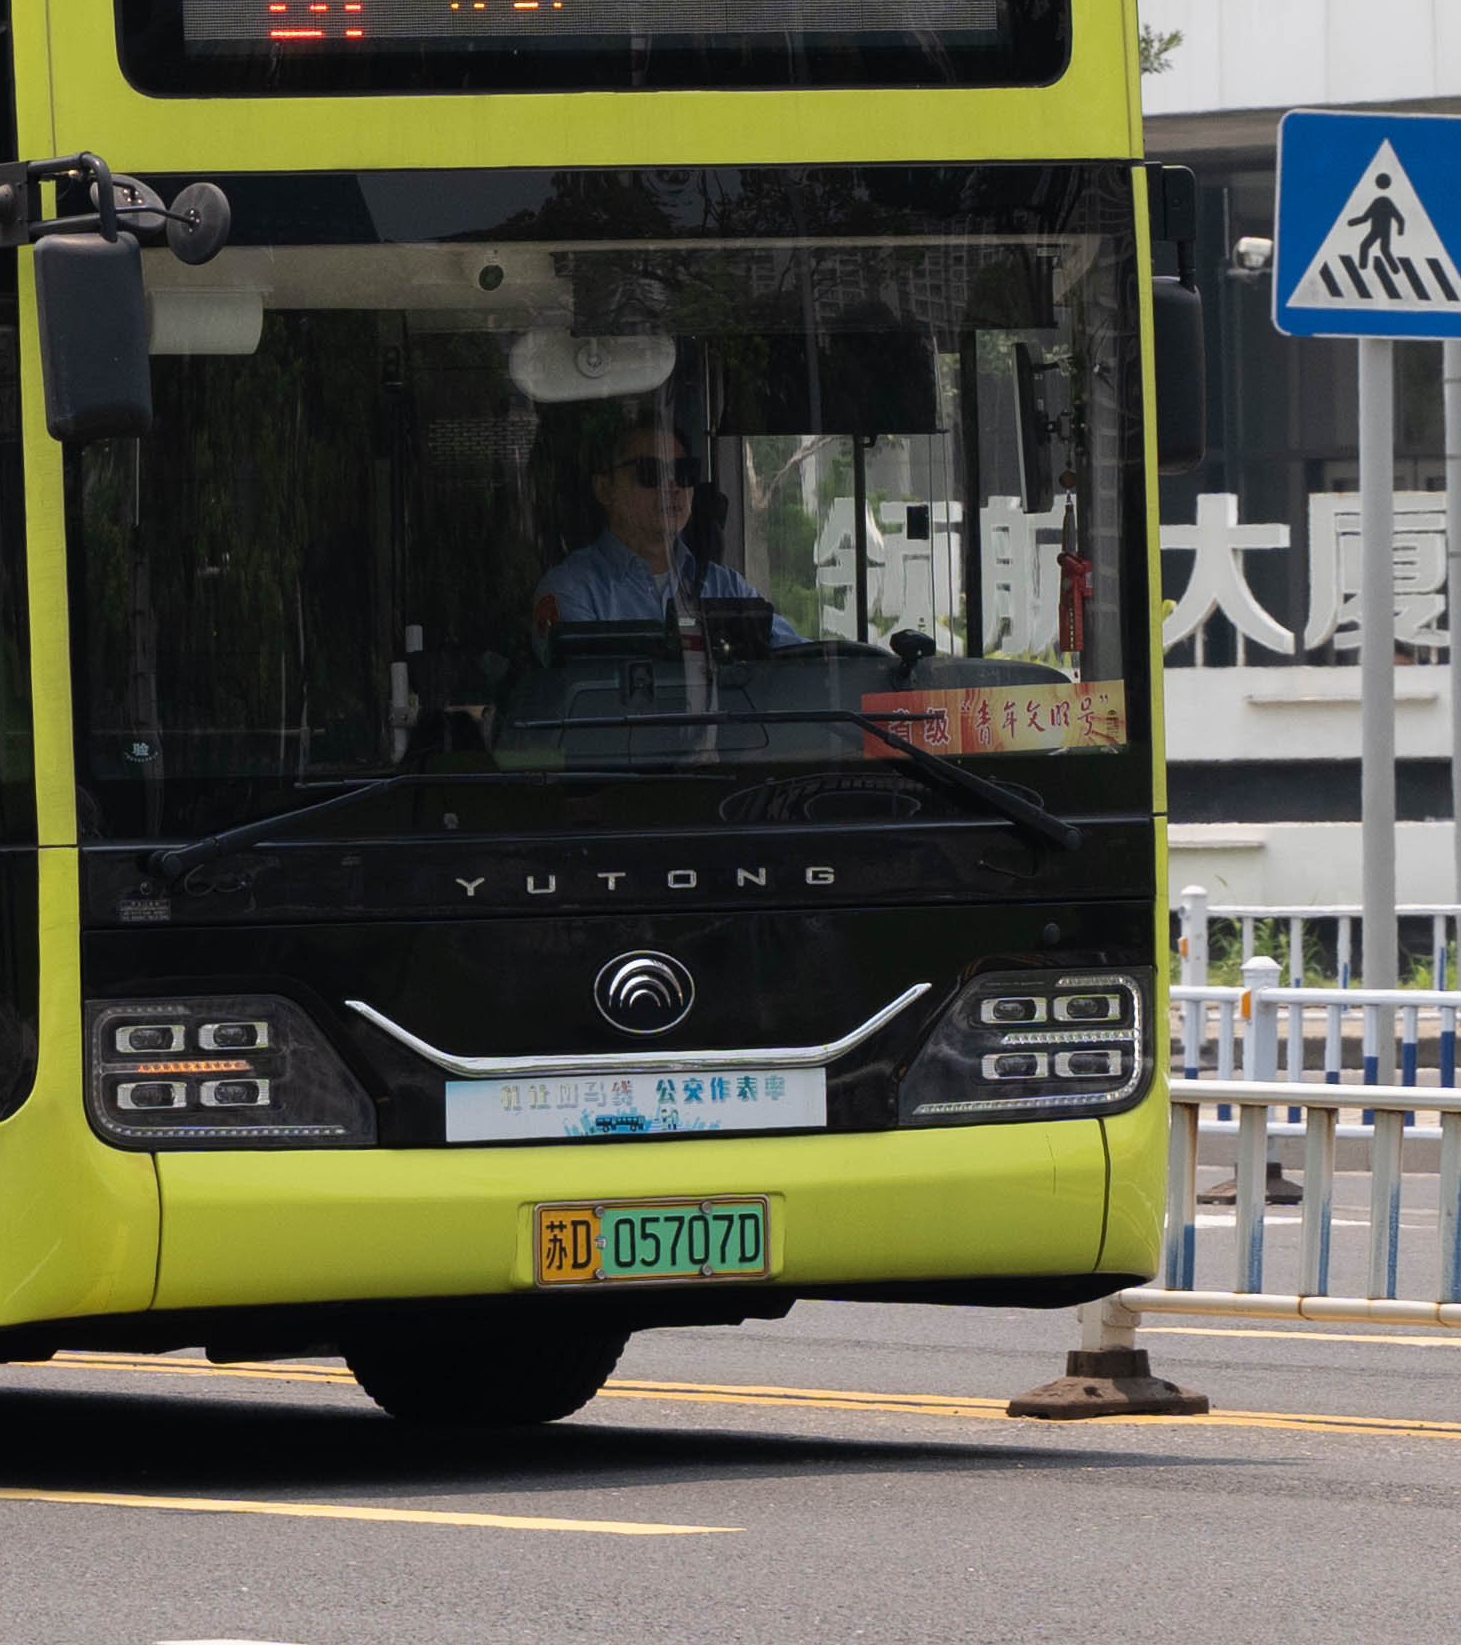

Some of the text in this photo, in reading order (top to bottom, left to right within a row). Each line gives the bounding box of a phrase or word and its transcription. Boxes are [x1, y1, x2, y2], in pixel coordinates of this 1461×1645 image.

[455, 866, 836, 897] YUTONG
[655, 1074, 786, 1106] 公交作表率
